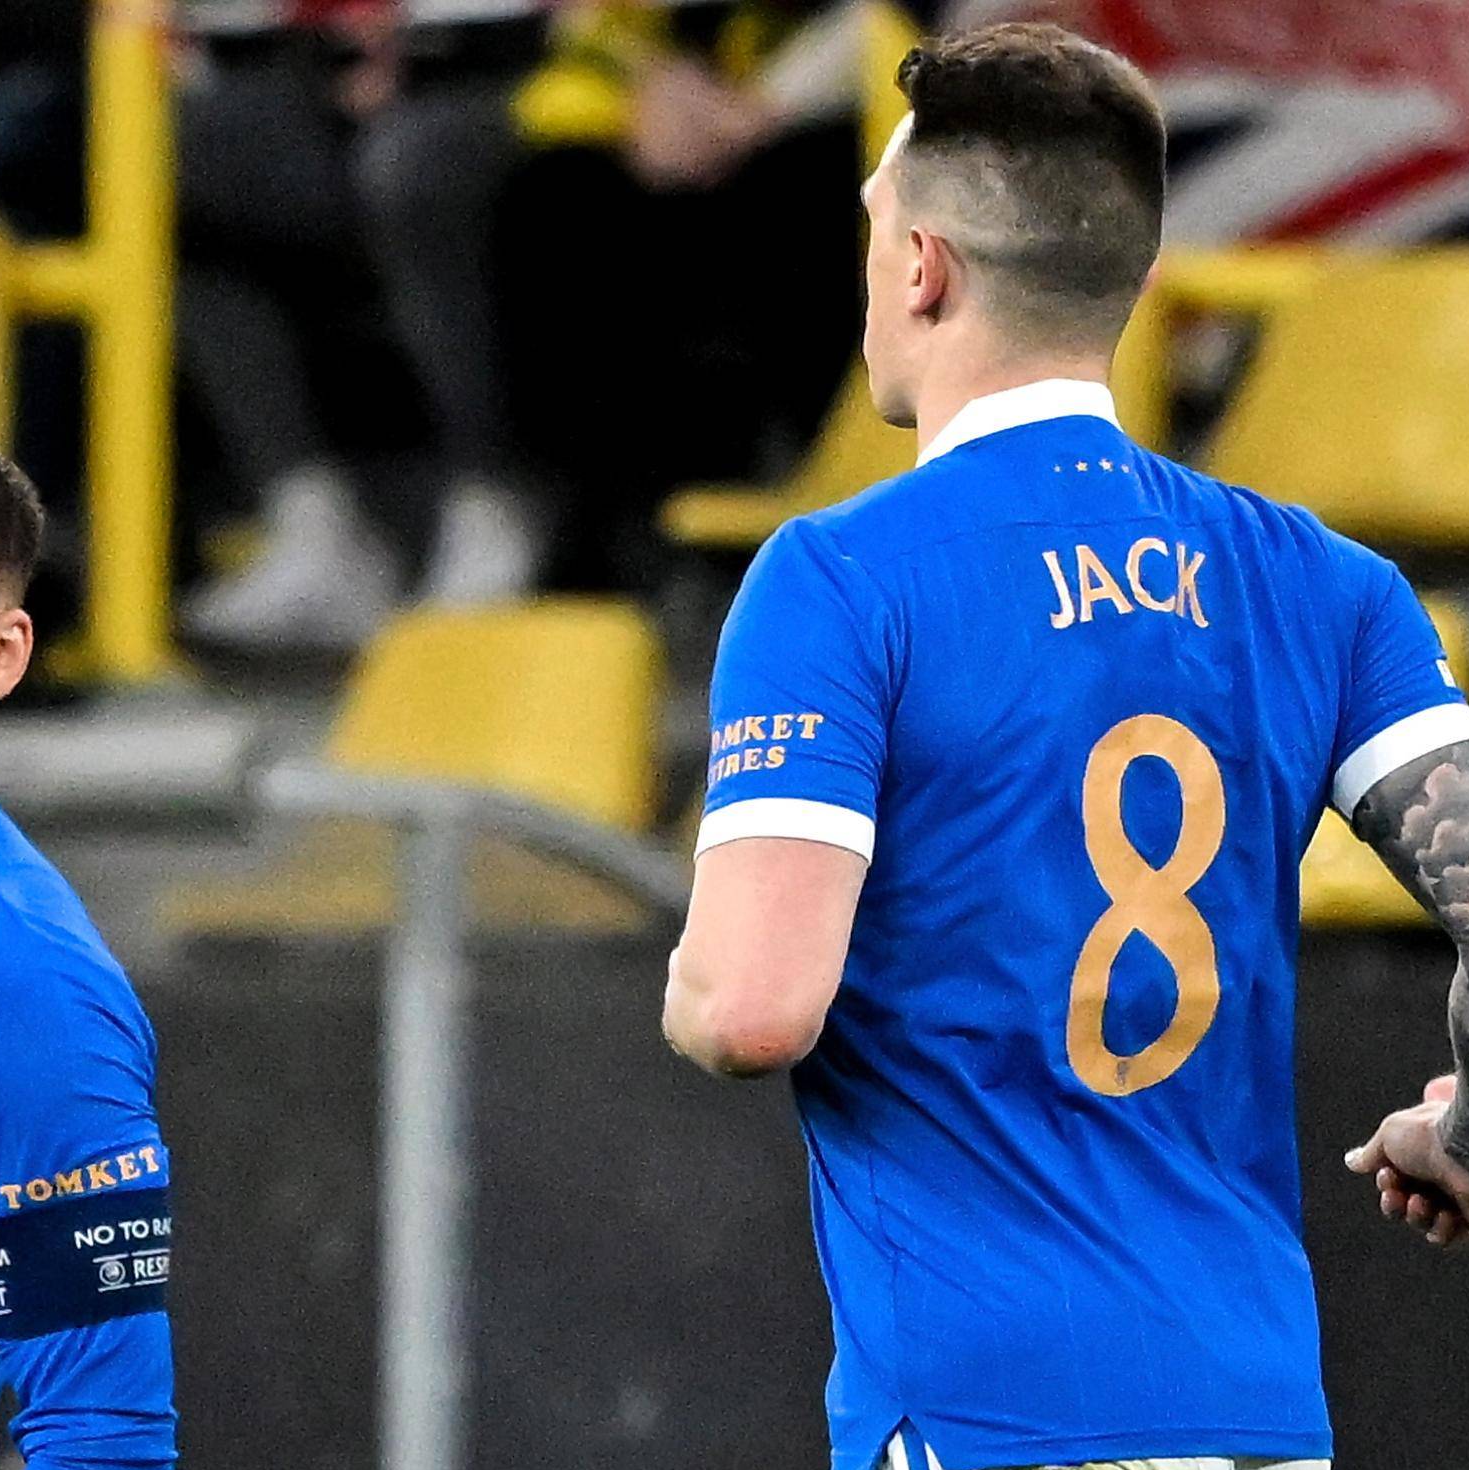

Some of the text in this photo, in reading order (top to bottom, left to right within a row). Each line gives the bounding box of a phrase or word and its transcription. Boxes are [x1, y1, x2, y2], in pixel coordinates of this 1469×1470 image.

[1041, 536, 1210, 630] JACK
[1065, 713, 1227, 1098] 8
[0, 1145, 161, 1210] TOMKET
[74, 1225, 116, 1250] NO
[118, 1219, 150, 1242] TO
